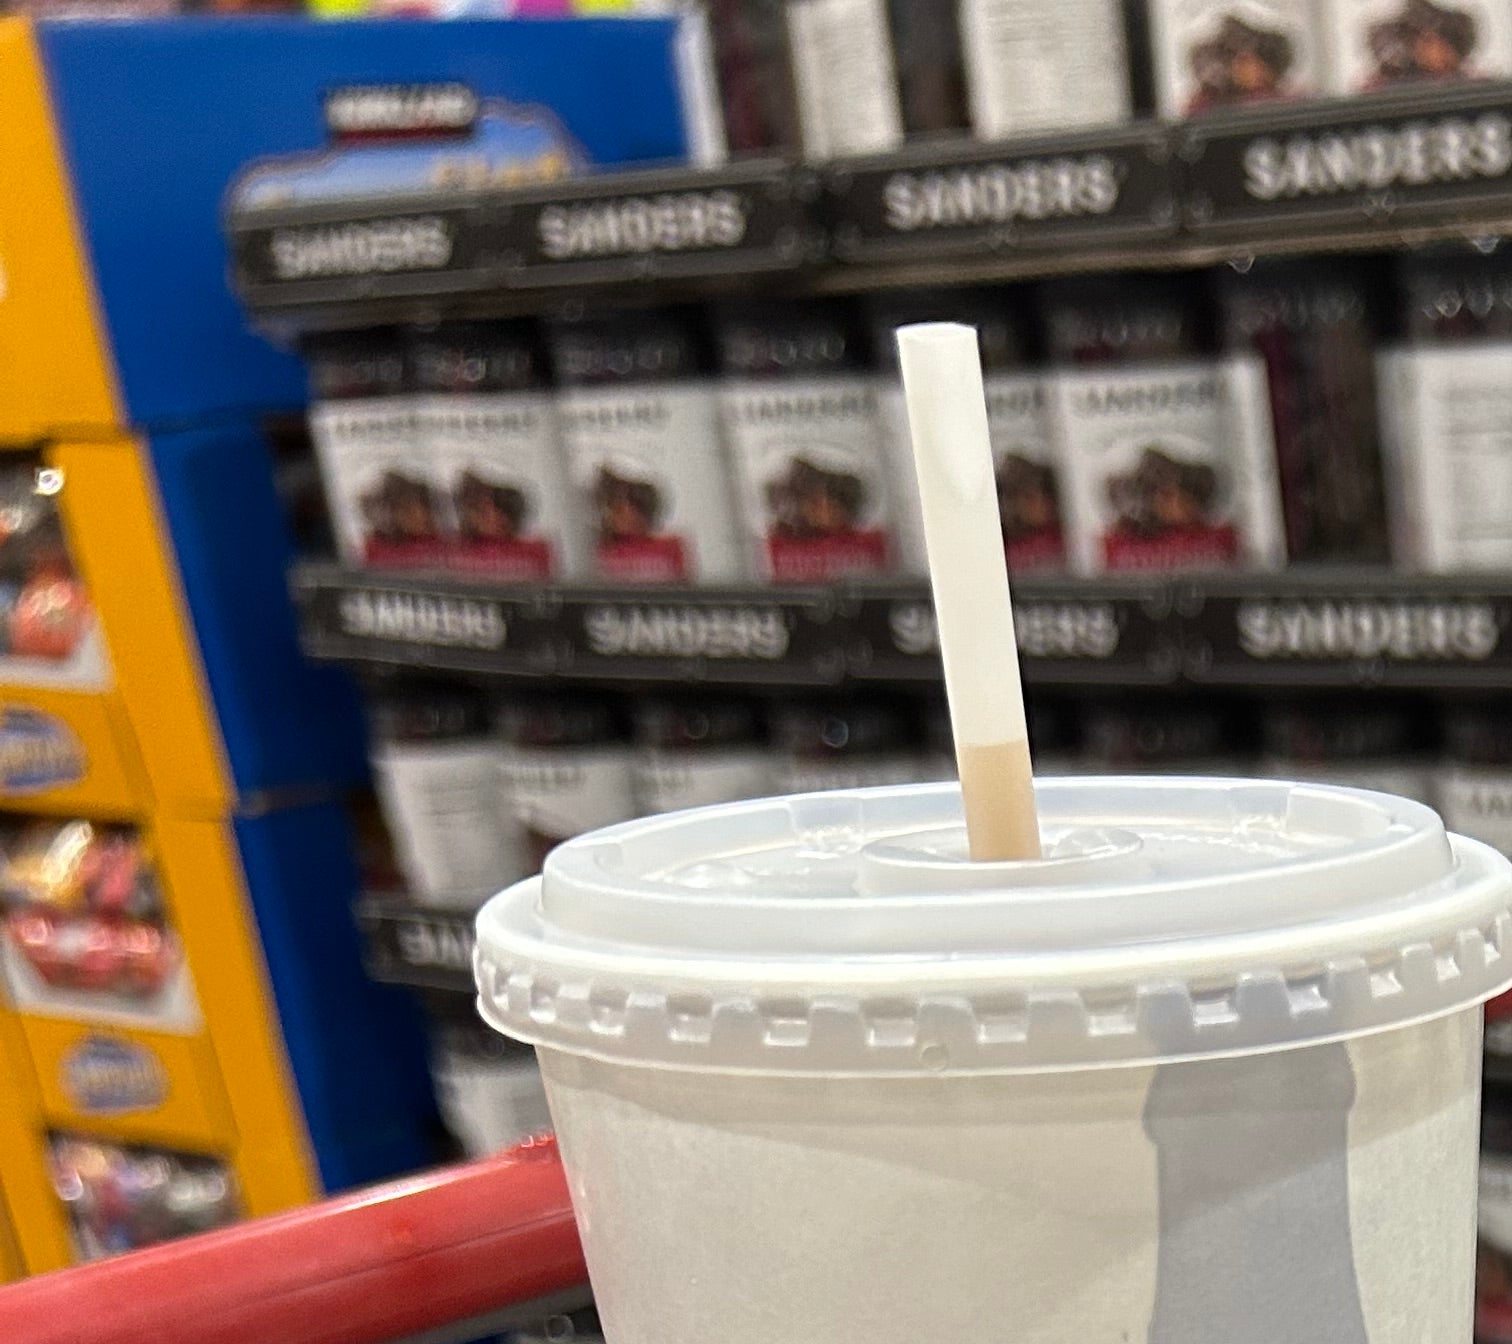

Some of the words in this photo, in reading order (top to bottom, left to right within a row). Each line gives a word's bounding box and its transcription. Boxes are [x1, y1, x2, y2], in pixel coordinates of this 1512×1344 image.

[884, 155, 1119, 230] SANDERS
[537, 192, 748, 260] SANDERS
[585, 605, 791, 660] SANDERS
[1237, 605, 1498, 660] SANDERS
